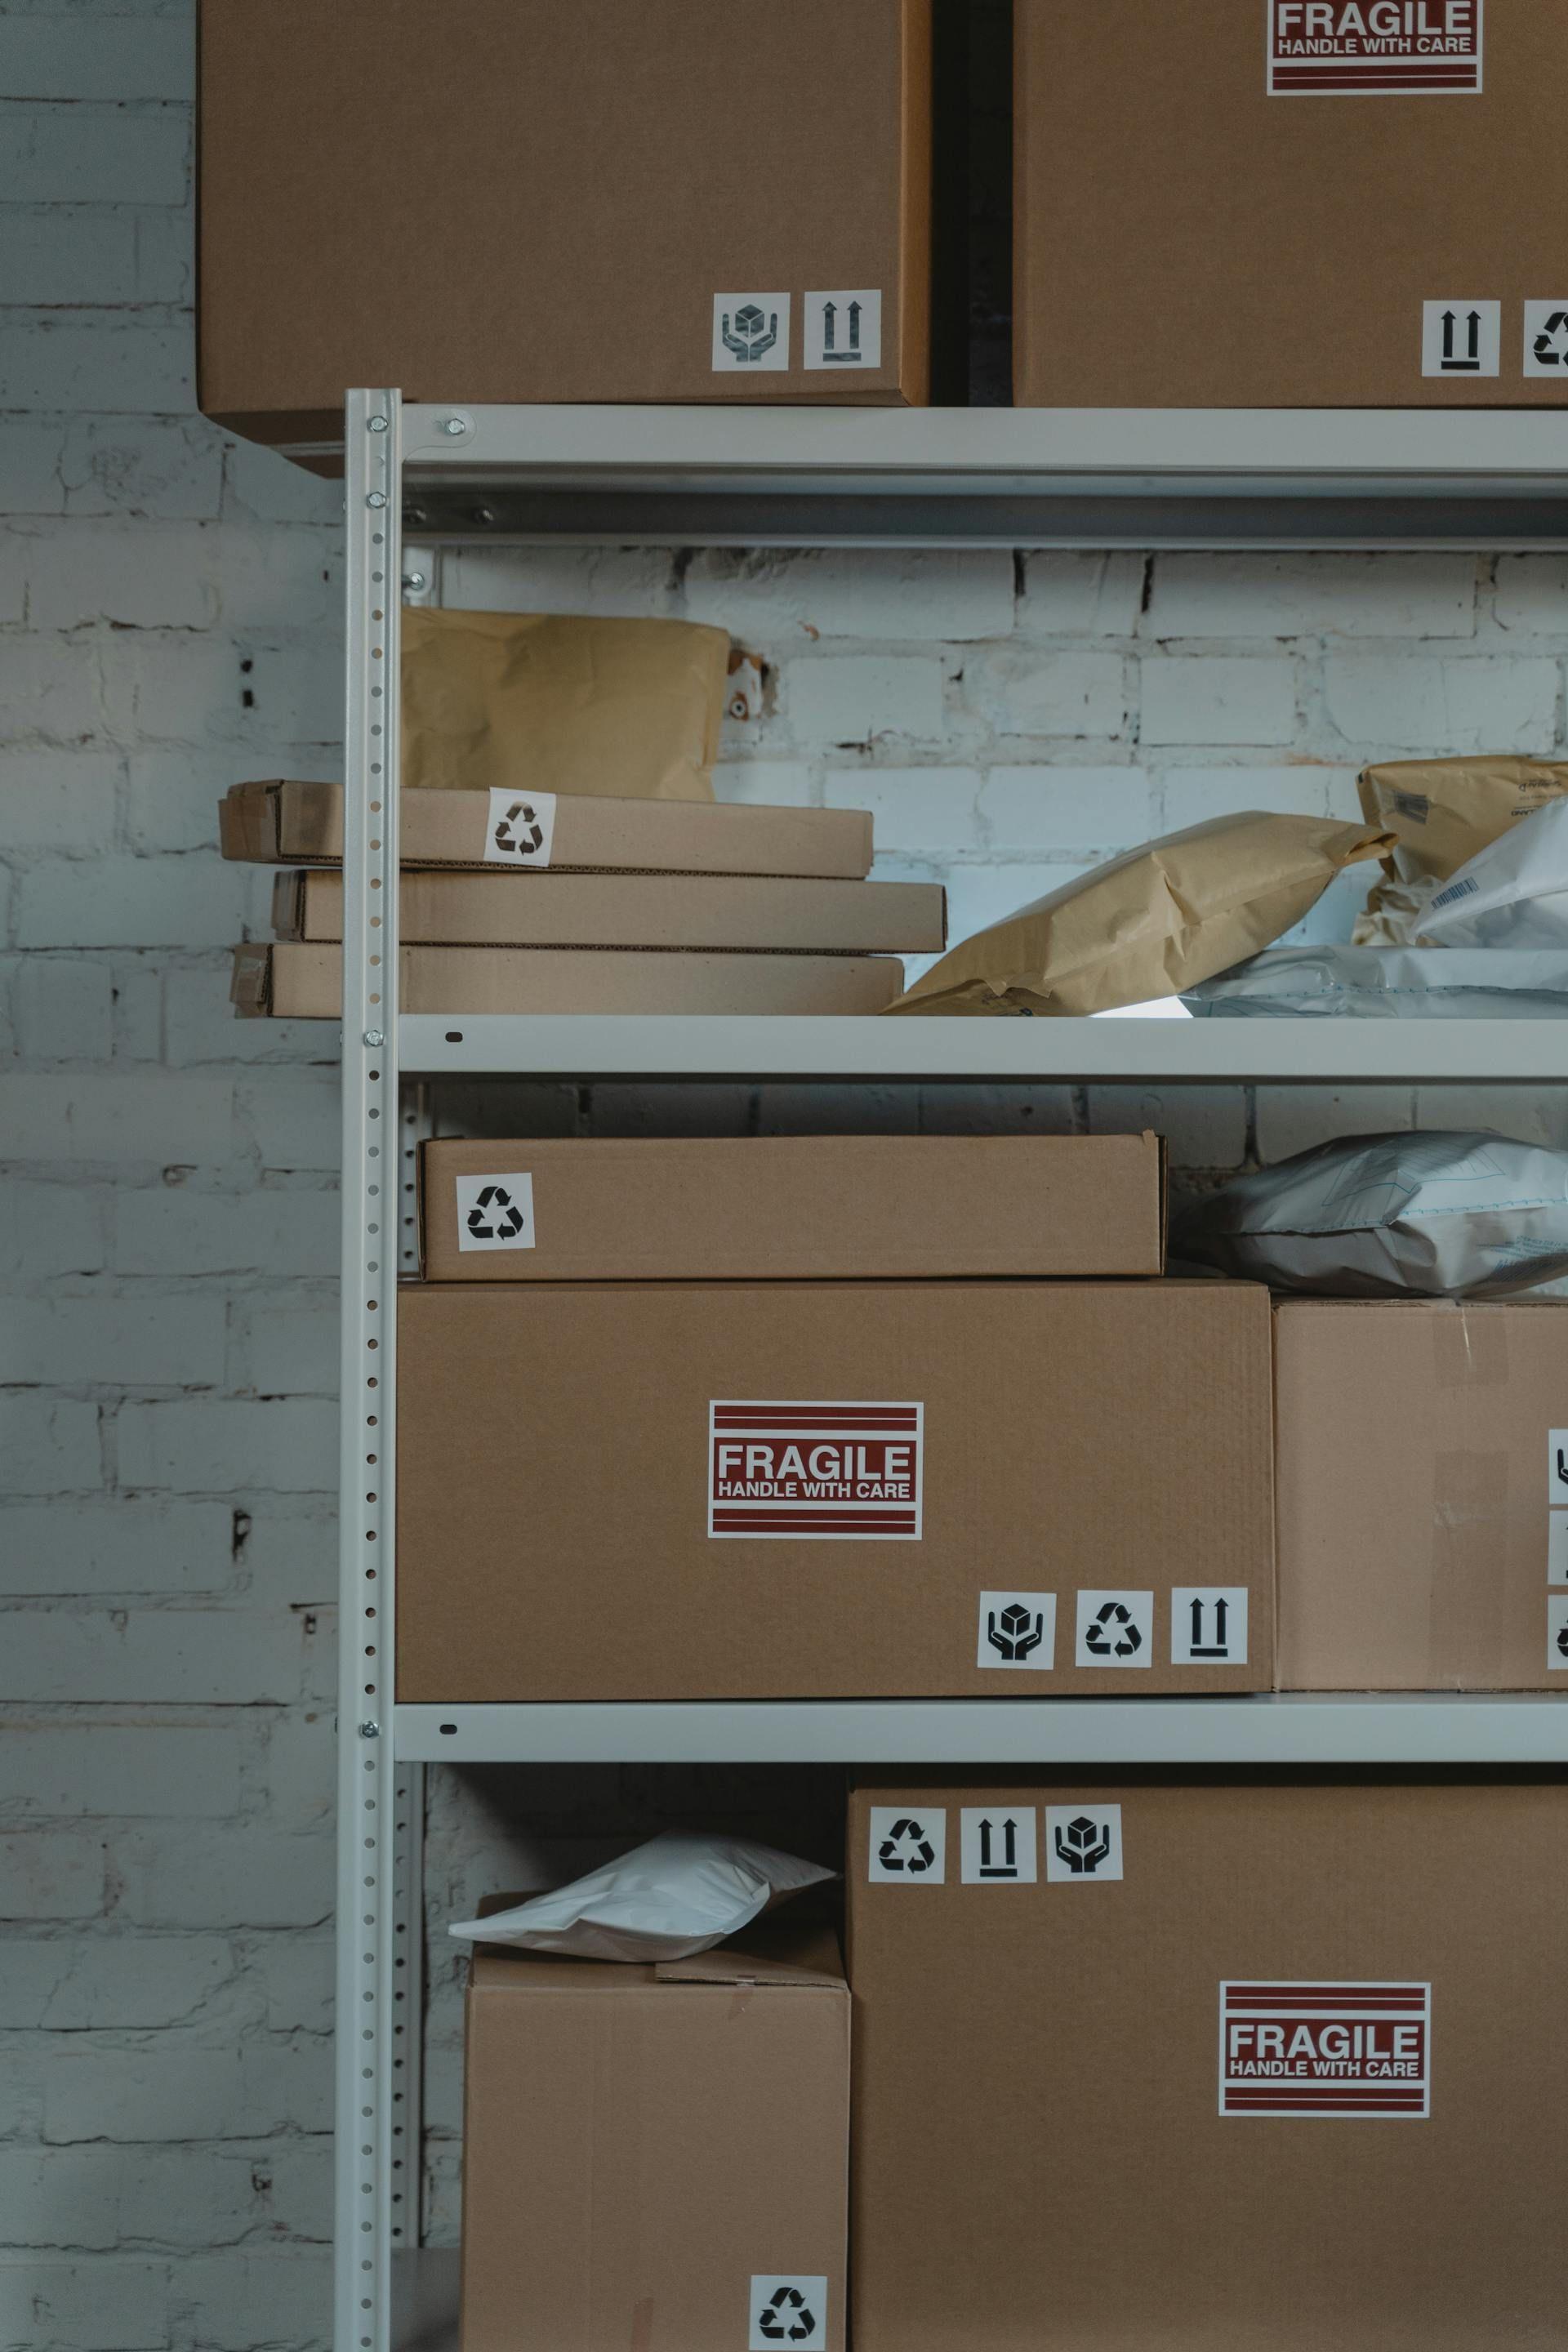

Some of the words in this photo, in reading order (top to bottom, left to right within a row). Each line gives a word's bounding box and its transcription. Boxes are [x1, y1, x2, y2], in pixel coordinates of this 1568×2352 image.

[1277, 0, 1472, 37] FRAGILE
[1278, 38, 1357, 55] HANDLE
[1362, 38, 1411, 54] WITH
[1416, 37, 1472, 53] CARE
[718, 1444, 911, 1481] FRAGILE
[718, 1481, 798, 1498] HANDLE
[803, 1482, 851, 1499] WITH
[856, 1482, 911, 1499] CARE
[1229, 2024, 1419, 2060] FRAGILE
[1230, 2060, 1308, 2077] HANDLE
[1312, 2060, 1361, 2078] WITH
[1365, 2061, 1419, 2078] CARE
